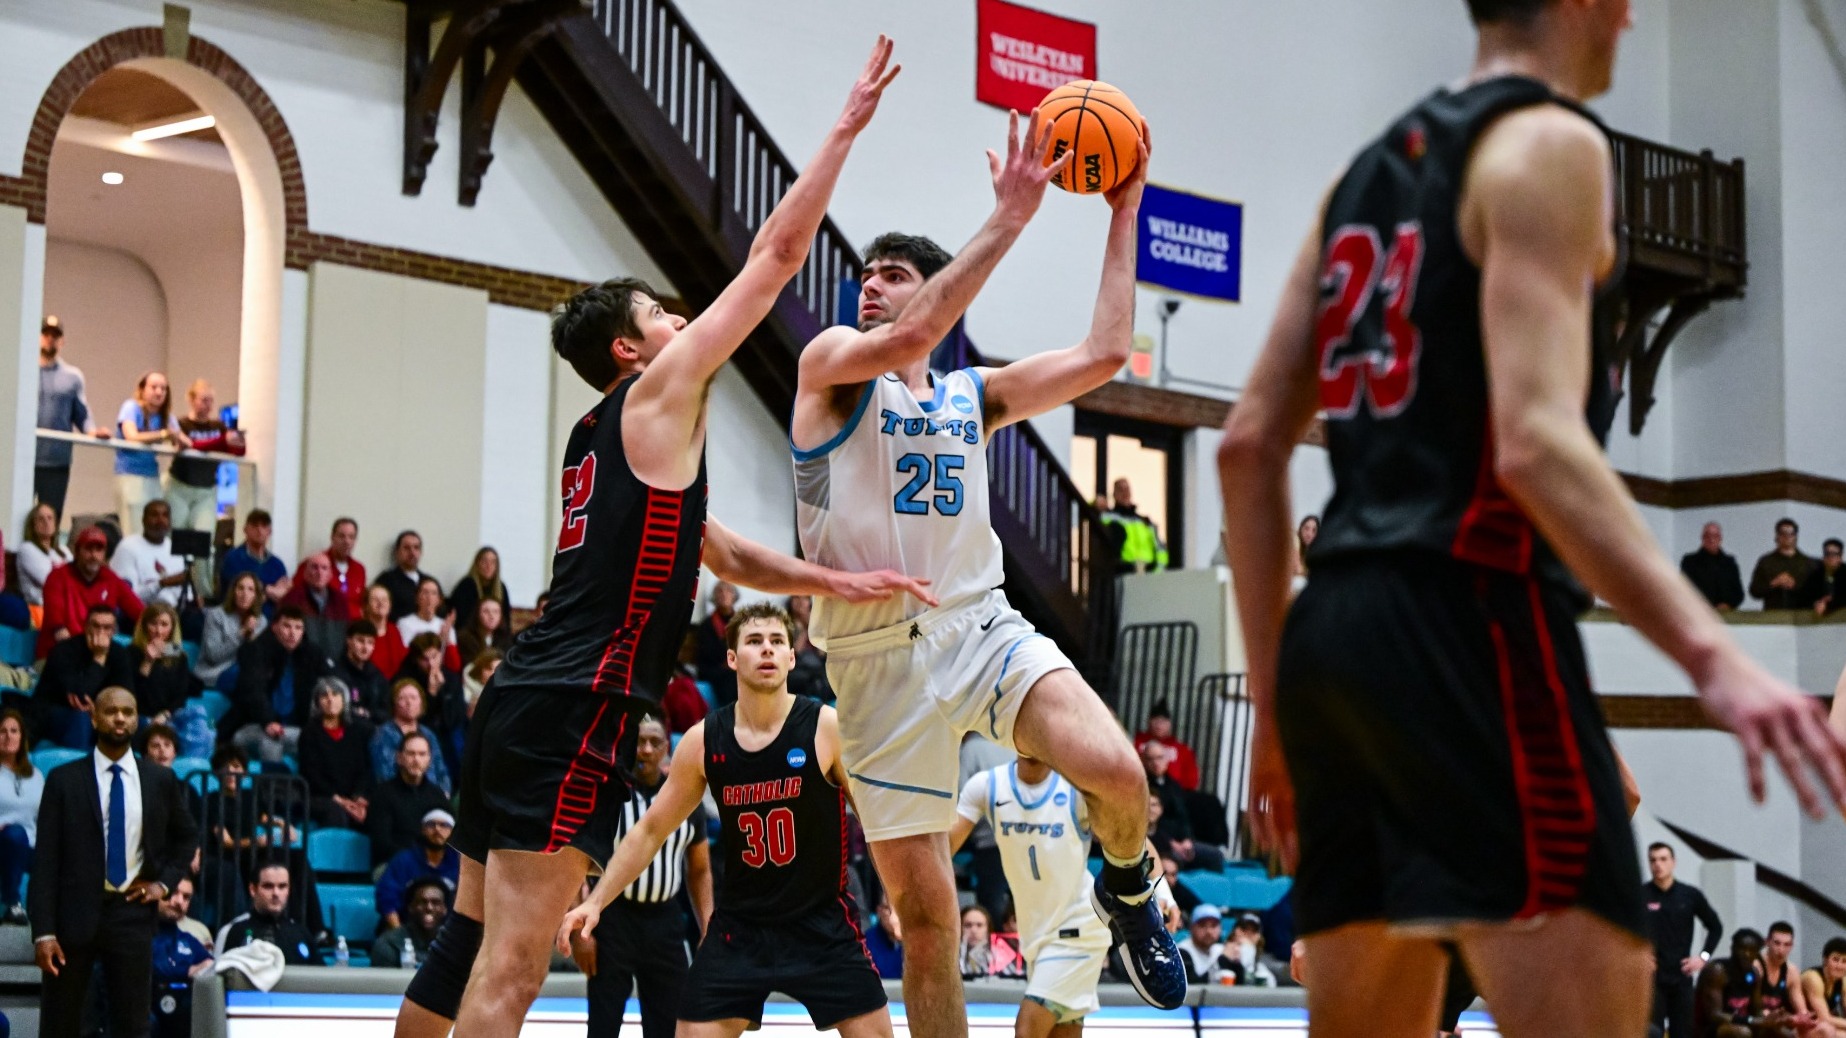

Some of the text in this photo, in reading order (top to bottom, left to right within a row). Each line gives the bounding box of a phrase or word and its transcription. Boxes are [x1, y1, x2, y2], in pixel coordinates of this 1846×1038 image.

[990, 31, 1084, 75] WESLEYAN
[1085, 153, 1101, 192] NCAA
[1147, 215, 1230, 252] WILLIAMS
[1317, 221, 1426, 420] 23
[893, 452, 965, 516] 25
[723, 776, 802, 806] CATHOLIC
[737, 806, 796, 869] 30
[1028, 844, 1041, 880] 1
